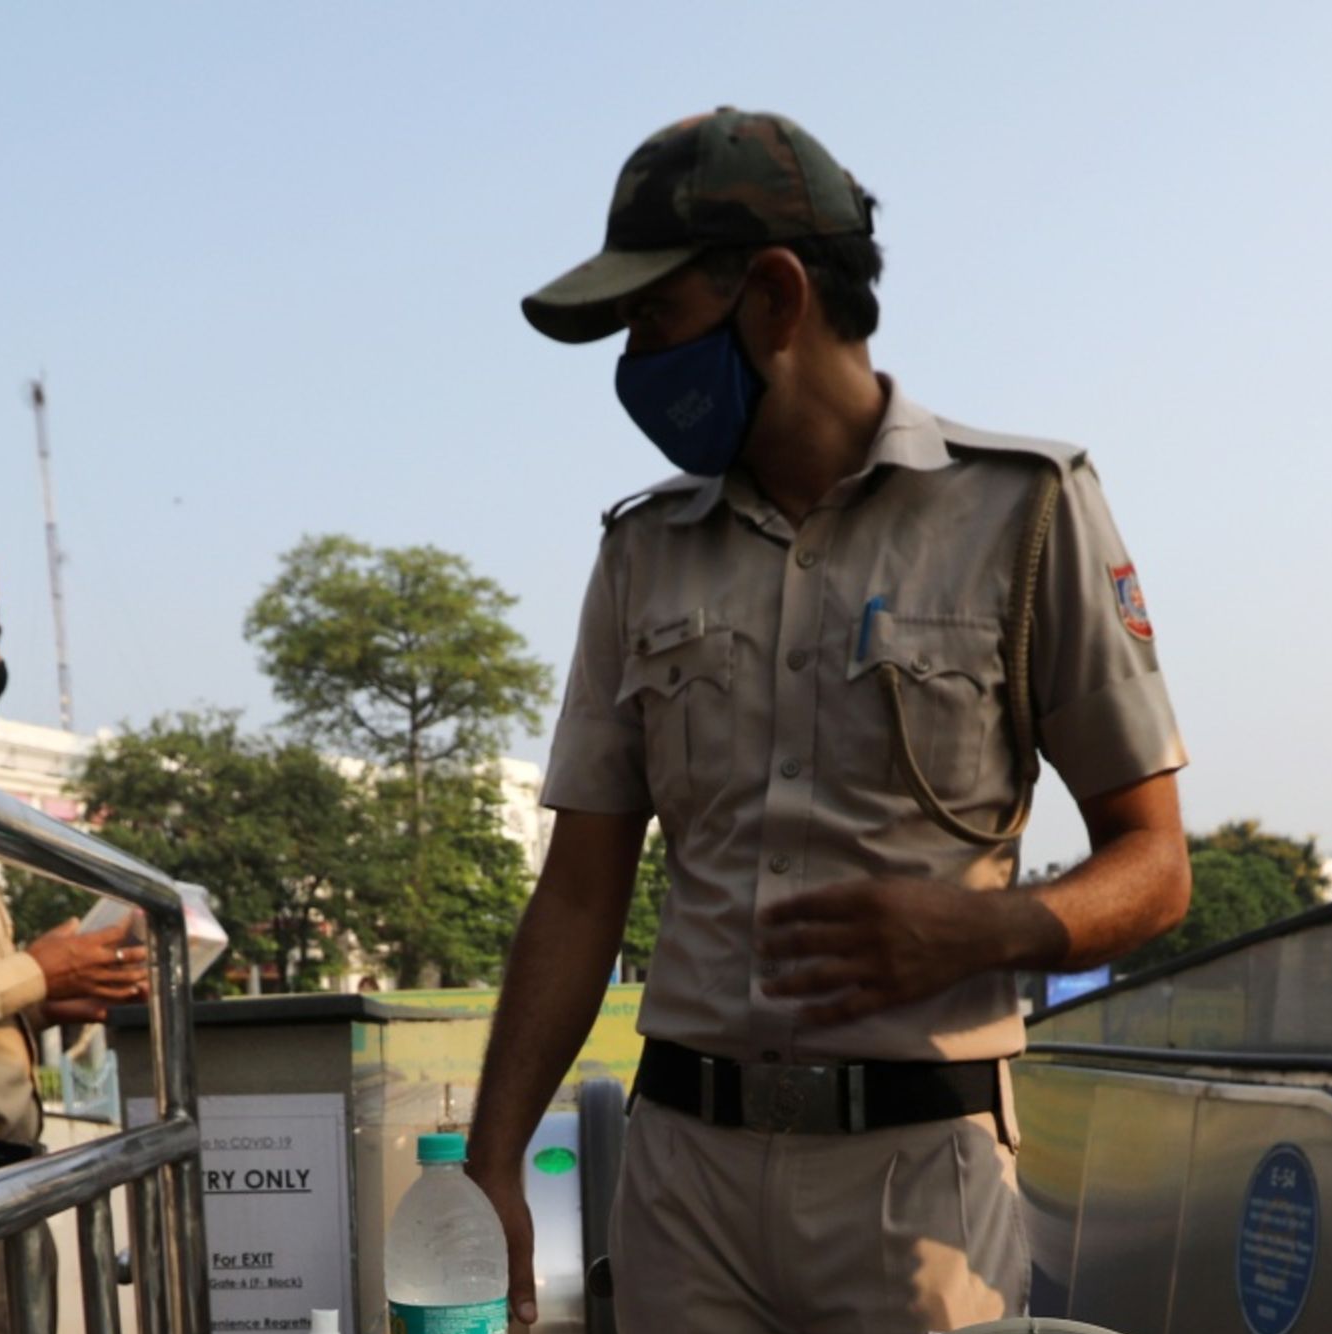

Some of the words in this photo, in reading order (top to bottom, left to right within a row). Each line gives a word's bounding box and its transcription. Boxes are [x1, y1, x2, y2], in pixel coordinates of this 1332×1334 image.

[229, 1136, 293, 1150] COVID-19
[244, 1168, 310, 1189] ONLY
[212, 1253, 237, 1267] For
[241, 1252, 274, 1266] EXIT
